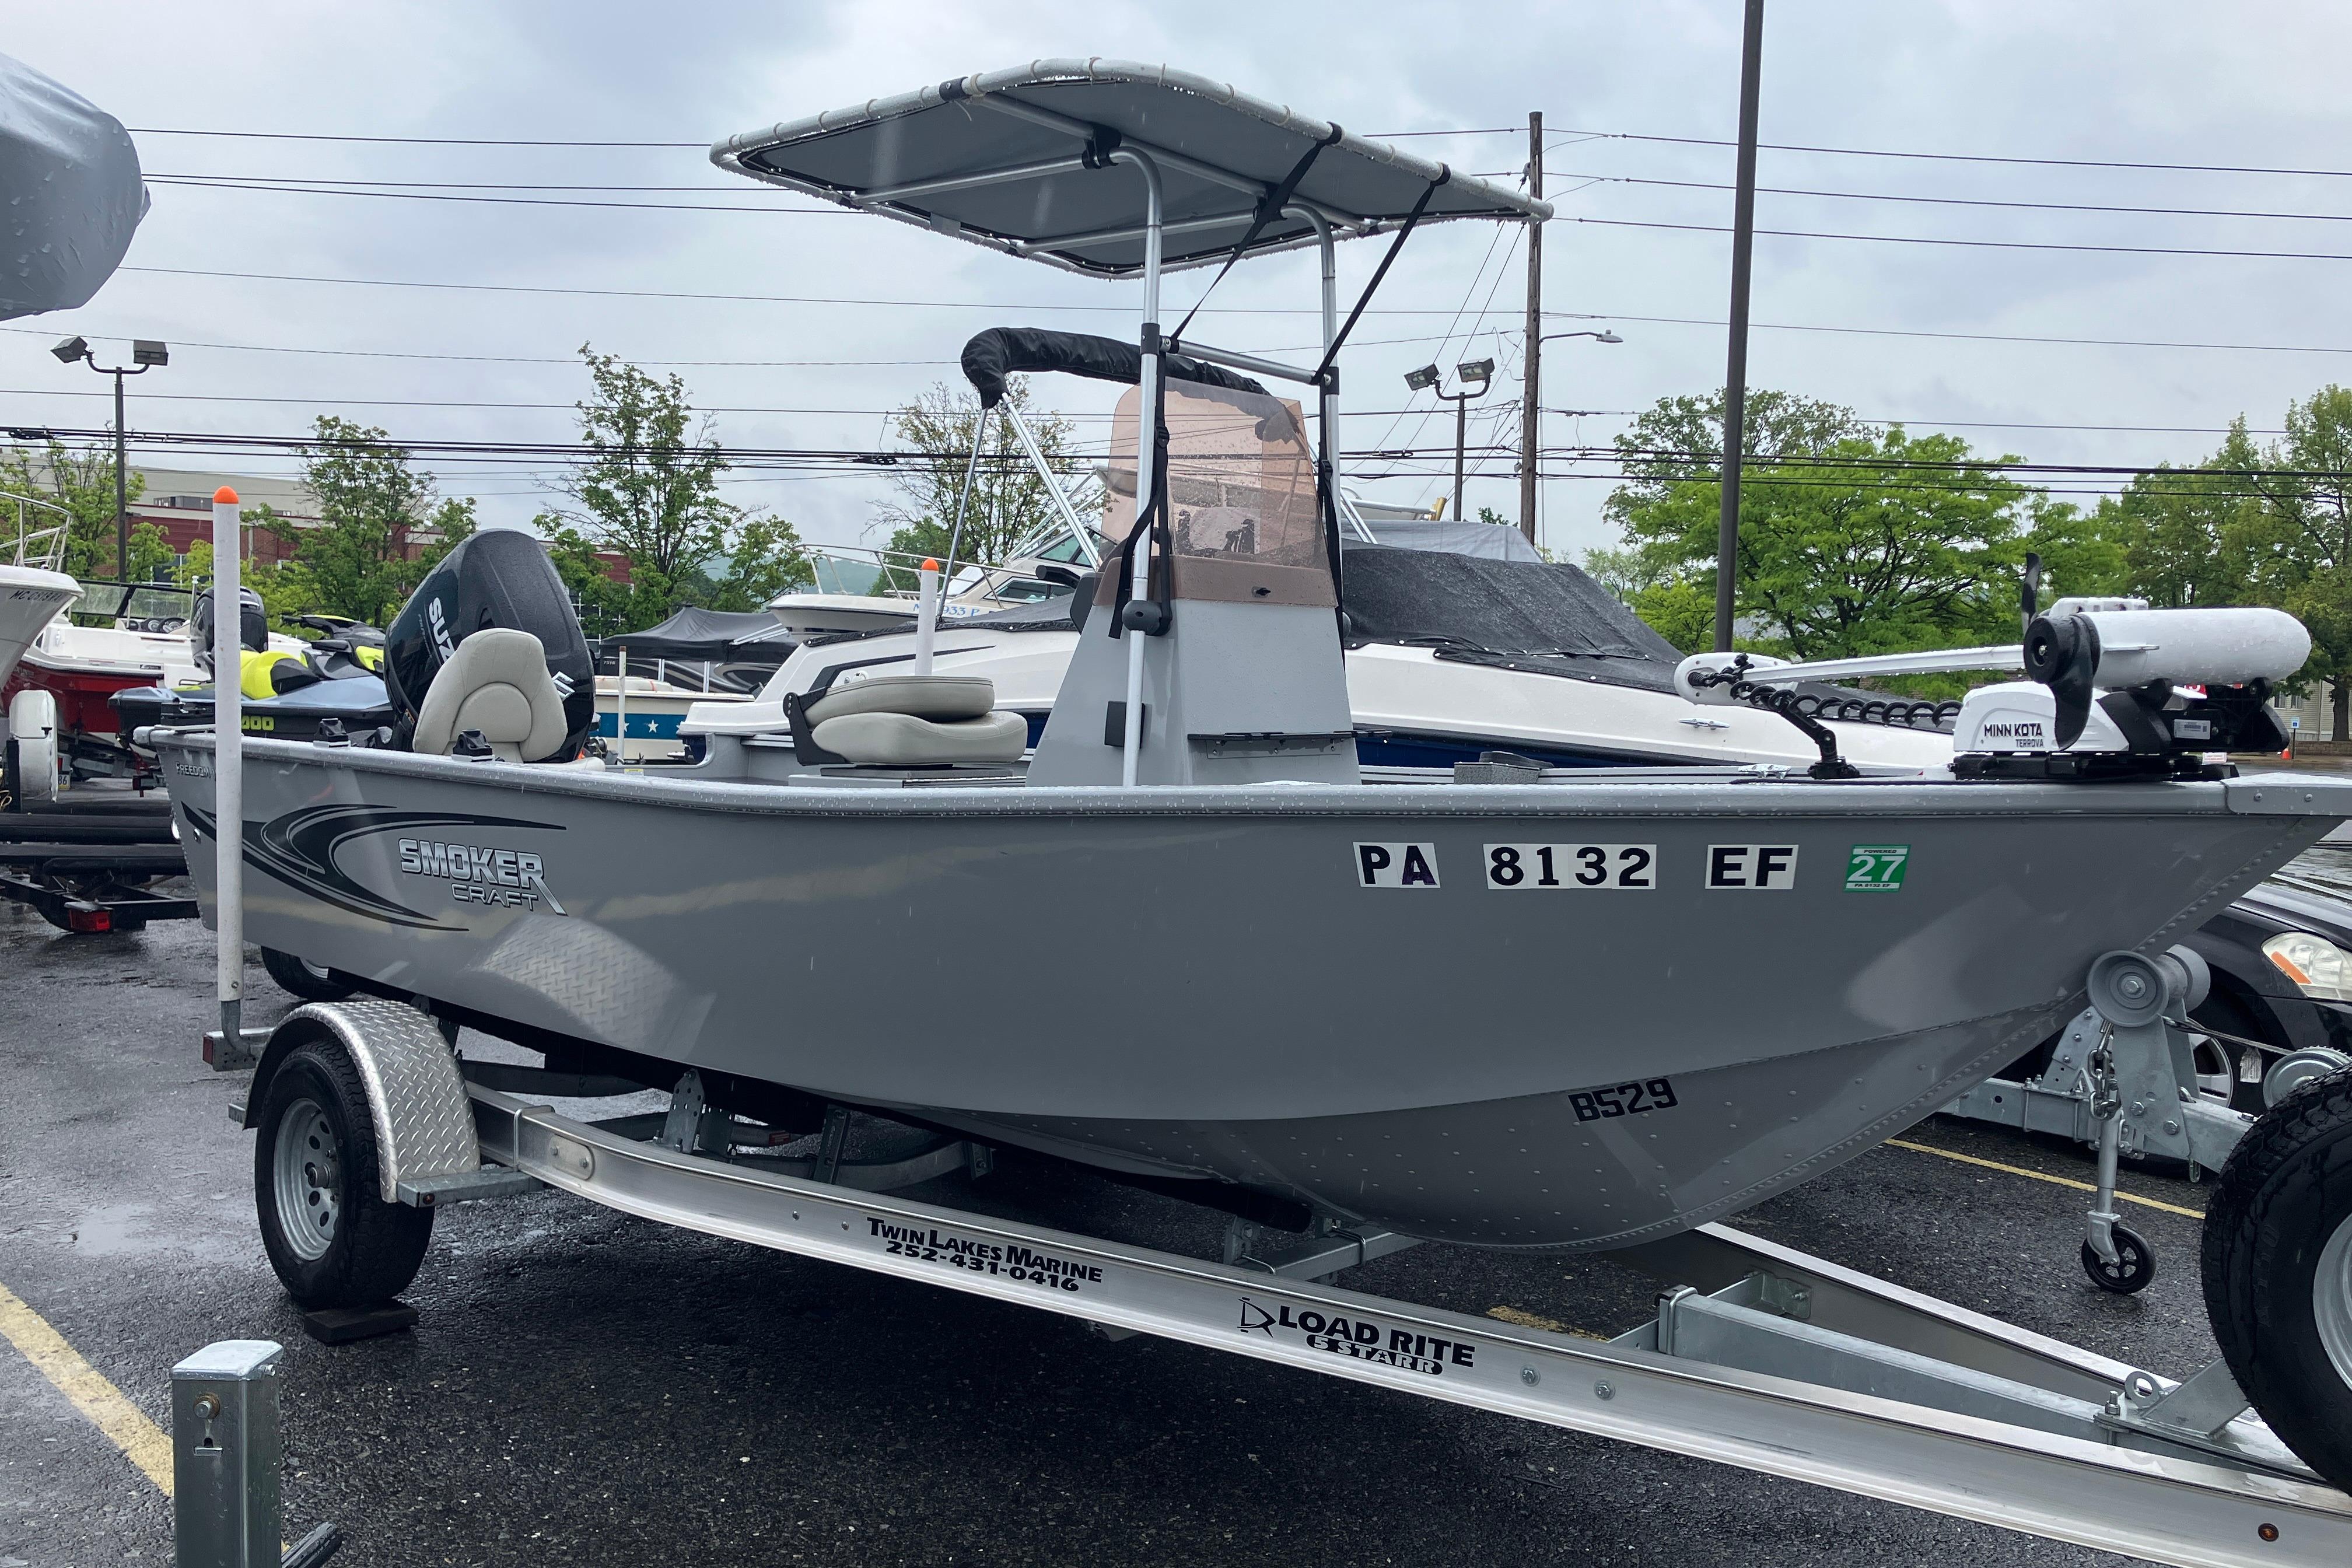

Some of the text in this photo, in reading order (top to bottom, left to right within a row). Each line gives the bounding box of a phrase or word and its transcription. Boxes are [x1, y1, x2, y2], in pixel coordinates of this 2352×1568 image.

[428, 597, 456, 663] SUZ
[943, 606, 966, 616] 933
[1984, 723, 2043, 737] MINN KOTA
[2015, 738, 2044, 747] TERROVA
[175, 761, 211, 779] FREEDOM
[398, 838, 568, 916] SMOKER
[1359, 845, 1793, 887] PA 8132 EF
[1847, 855, 1906, 881] 27
[451, 883, 538, 911] CRAFT
[1567, 1078, 1678, 1122] B529
[886, 1240, 1080, 1292] 252-431-0416
[1278, 1305, 1476, 1368] LOAD RITE
[1314, 1336, 1435, 1375] 5 STARR
